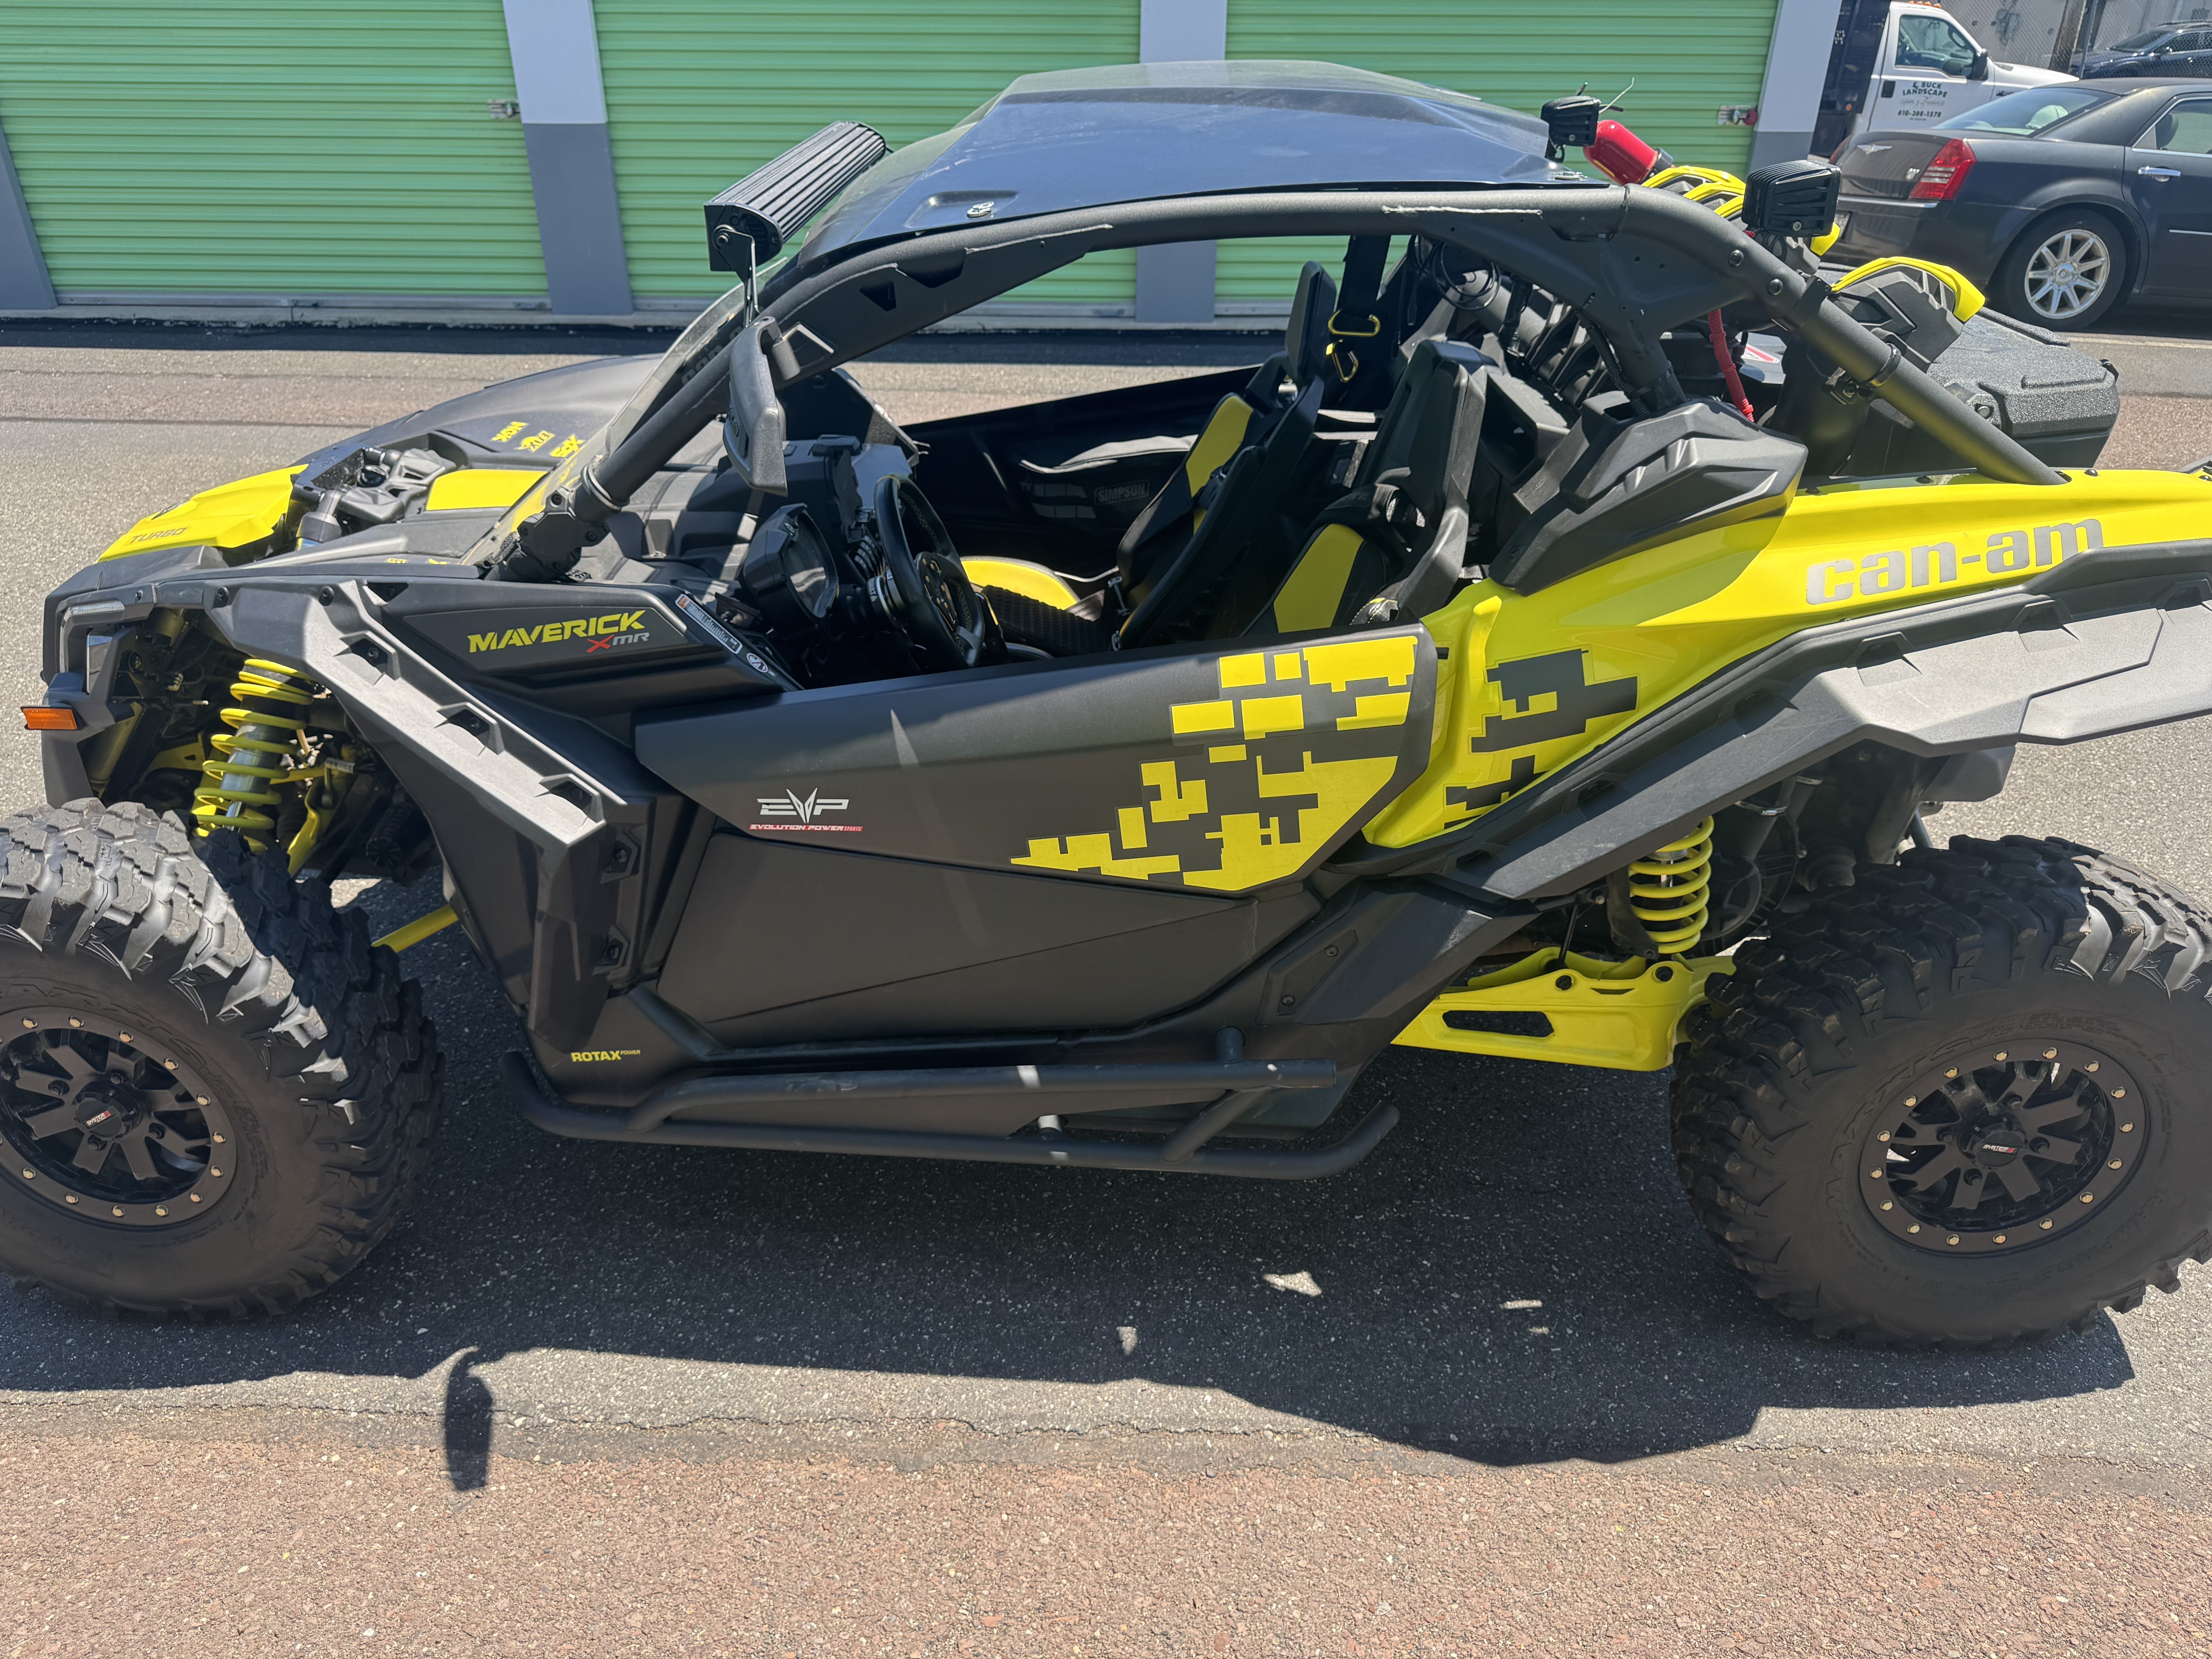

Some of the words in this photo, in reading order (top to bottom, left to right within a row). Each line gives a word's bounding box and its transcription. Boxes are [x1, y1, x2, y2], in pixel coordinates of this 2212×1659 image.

[1903, 89, 1948, 98] LANDSCAPE
[1097, 483, 1146, 502] SIMPSON
[130, 527, 188, 544] TURBO
[1805, 518, 2104, 605] can-am
[467, 610, 646, 653] MAVERICK
[571, 1050, 622, 1062] ROTAX
